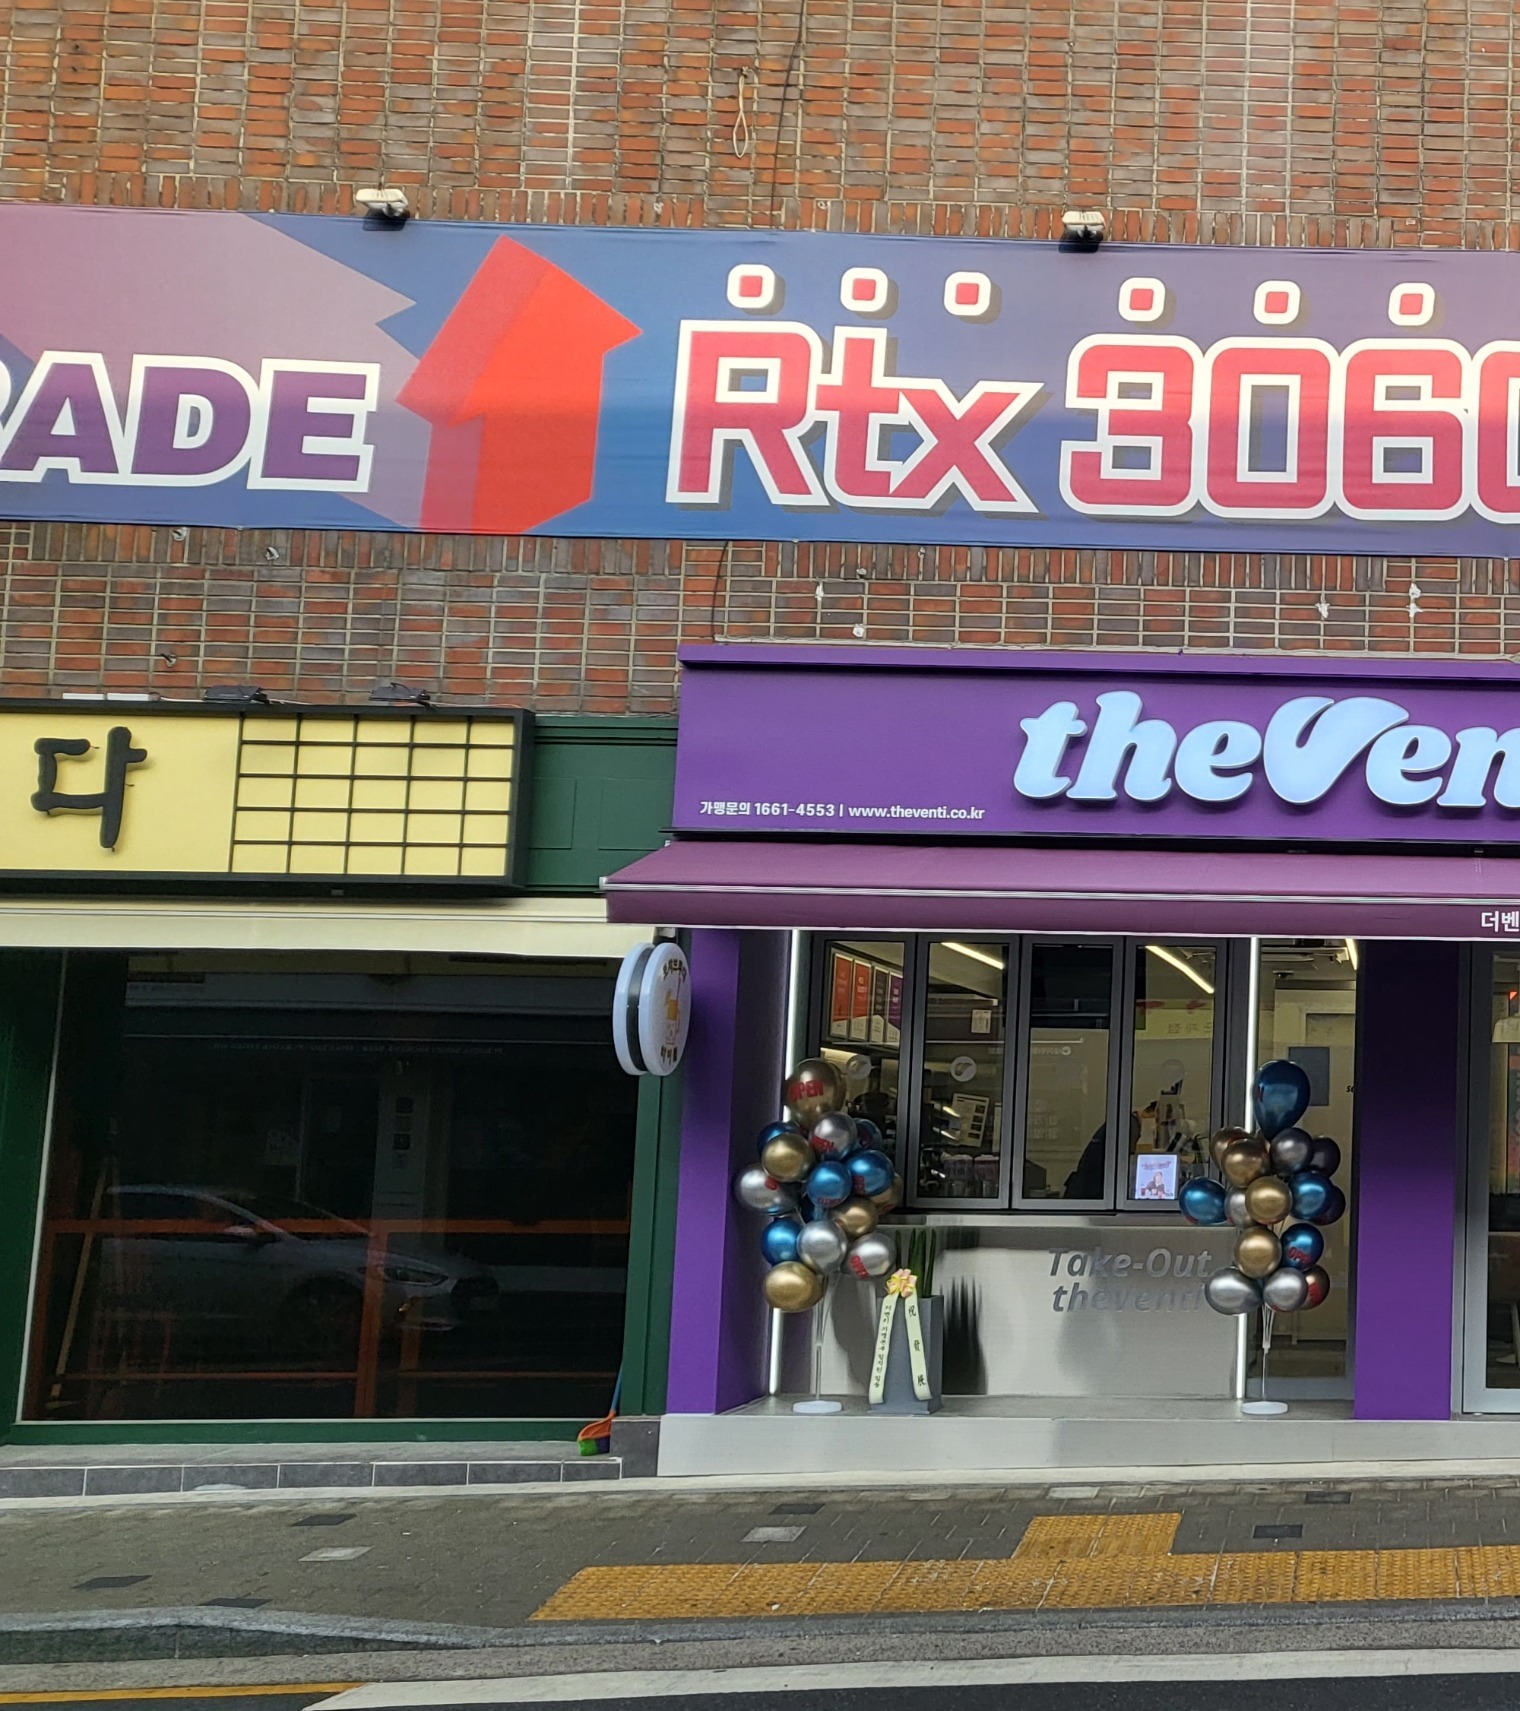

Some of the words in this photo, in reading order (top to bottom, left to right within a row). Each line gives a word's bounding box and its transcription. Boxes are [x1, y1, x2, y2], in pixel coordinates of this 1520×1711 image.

[0, 350, 381, 492] ADE
[666, 319, 1045, 513] Rtx
[30, 726, 148, 852] 다
[699, 801, 751, 817] 가맹문의
[753, 802, 836, 818] 1661-4553
[848, 805, 986, 821] www.theventi.co.kr
[1048, 1246, 1214, 1279] Take-Out
